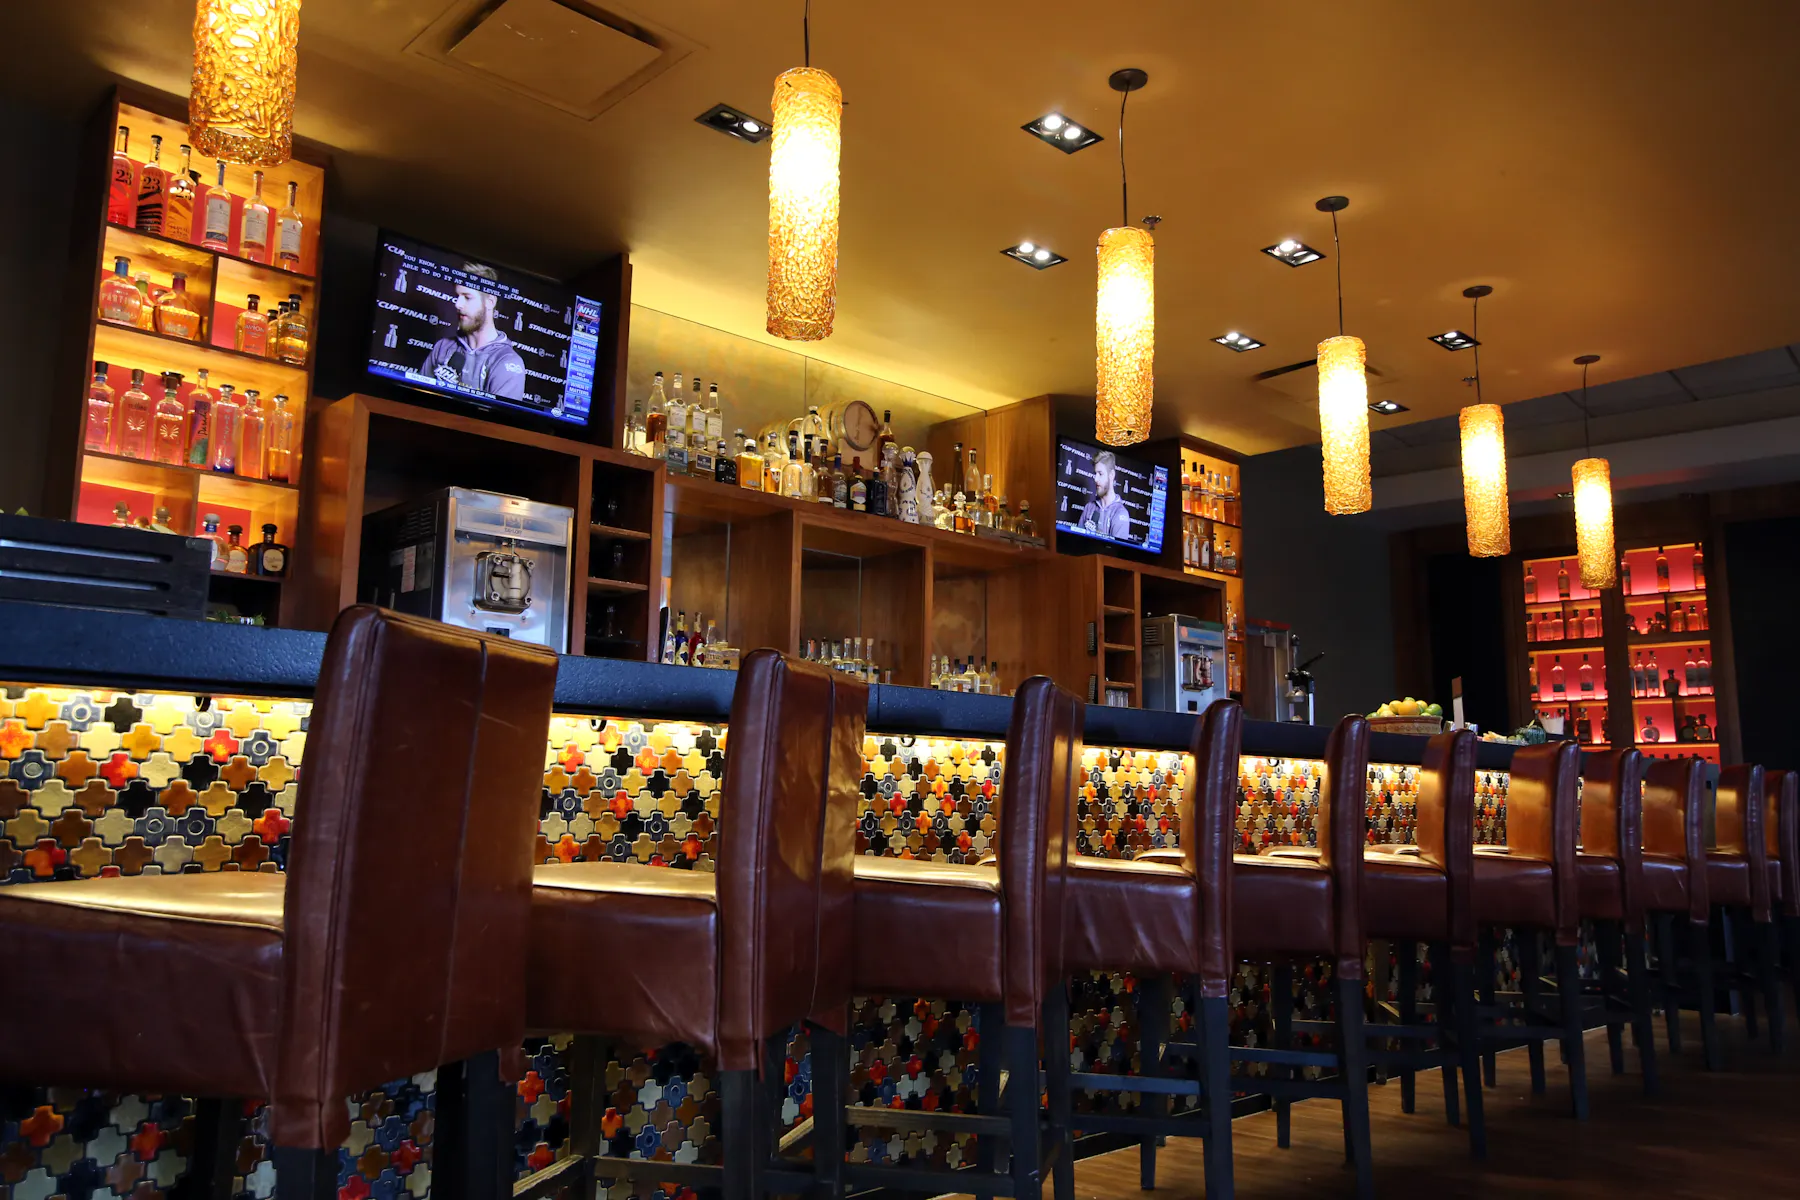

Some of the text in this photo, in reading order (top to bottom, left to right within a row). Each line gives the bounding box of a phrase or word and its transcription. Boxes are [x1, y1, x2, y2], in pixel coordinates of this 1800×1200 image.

[116, 170, 132, 186] 23
[143, 176, 160, 190] 23
[404, 254, 416, 262] YOU
[452, 269, 468, 278] COME
[480, 278, 496, 287] HERE
[402, 262, 418, 272] ABLE
[465, 282, 480, 290] THIS
[482, 287, 501, 296] LEVEL
[416, 284, 453, 302] STANLEY
[510, 293, 523, 301] CUP
[522, 298, 544, 310] FINAL
[378, 300, 400, 311] CUP
[399, 307, 428, 322] FINAL
[578, 306, 598, 318] NHL
[528, 323, 556, 336] STANLEY
[407, 338, 434, 350] STANL
[517, 344, 538, 354] FINAL
[389, 363, 418, 374] FINAL
[436, 366, 459, 381] NHL
[525, 369, 551, 380] STANLEY
